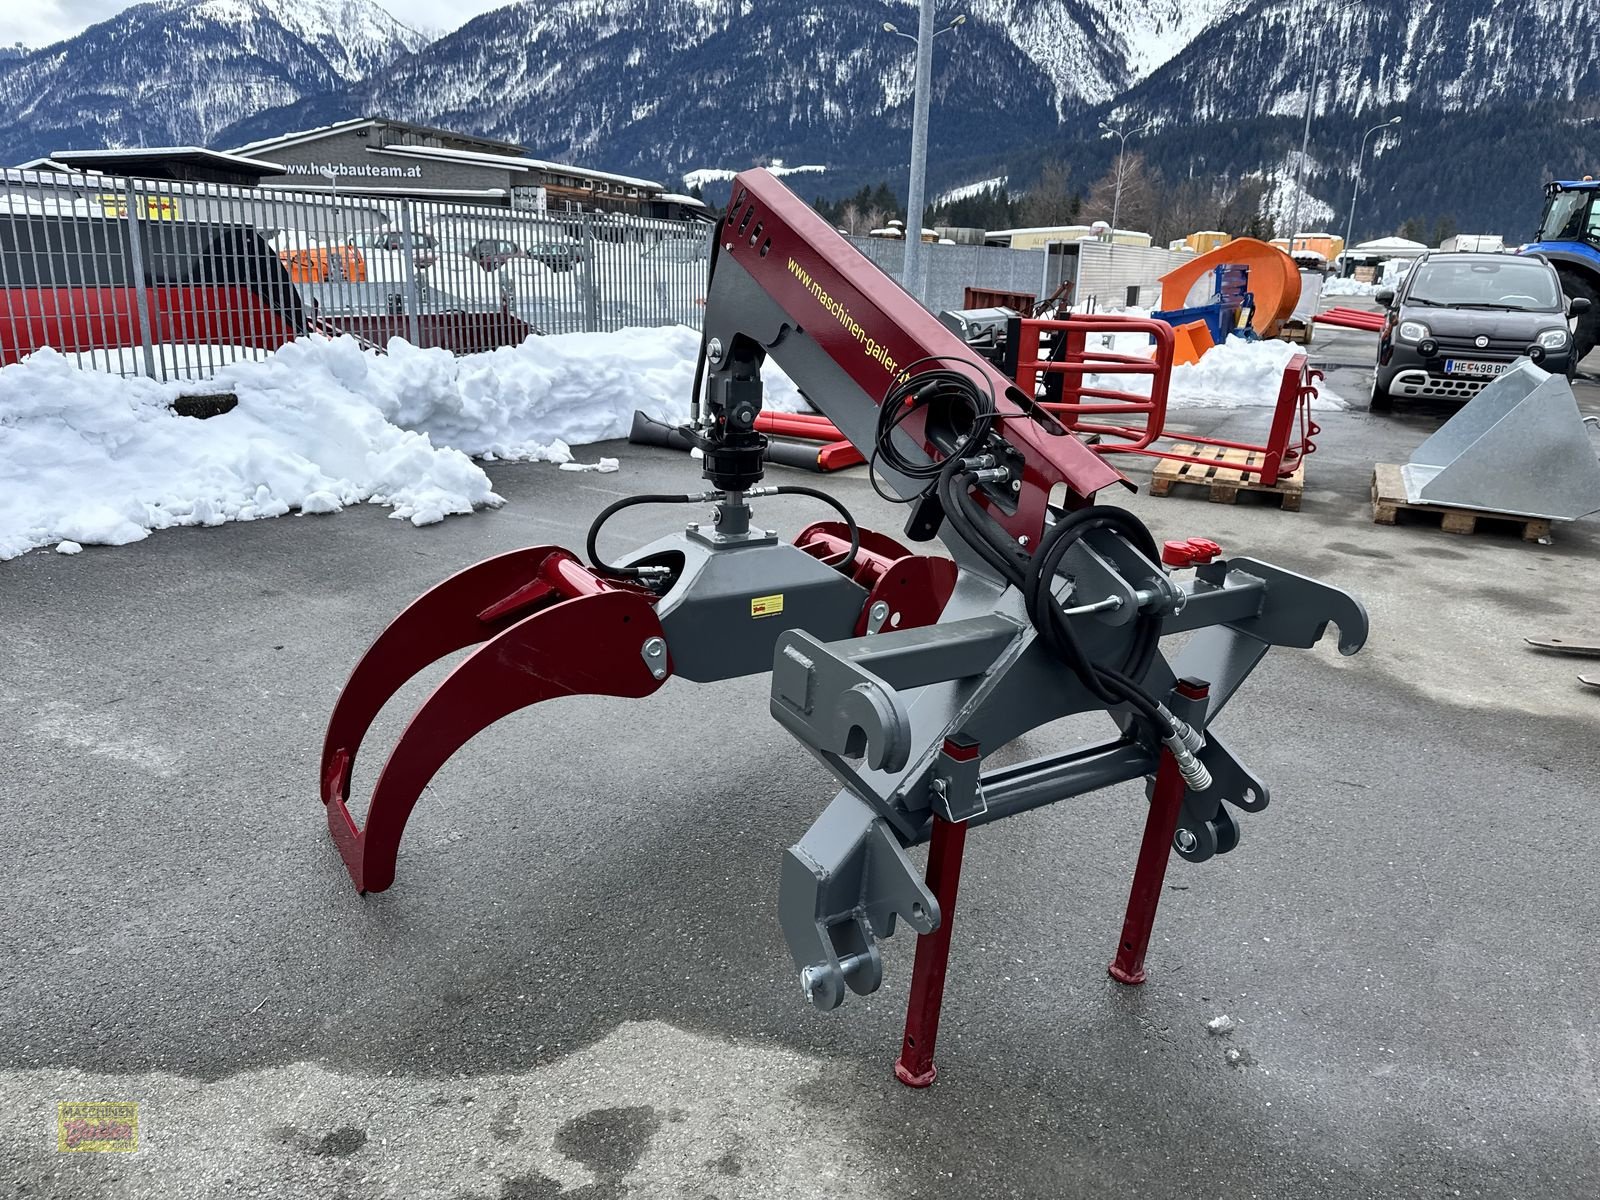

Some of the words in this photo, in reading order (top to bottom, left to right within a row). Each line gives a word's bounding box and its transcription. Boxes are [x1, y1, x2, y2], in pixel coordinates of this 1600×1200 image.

[282, 162, 422, 177] ww.holzbauteam.at
[1454, 362, 1467, 372] HE
[1474, 363, 1493, 374] 498
